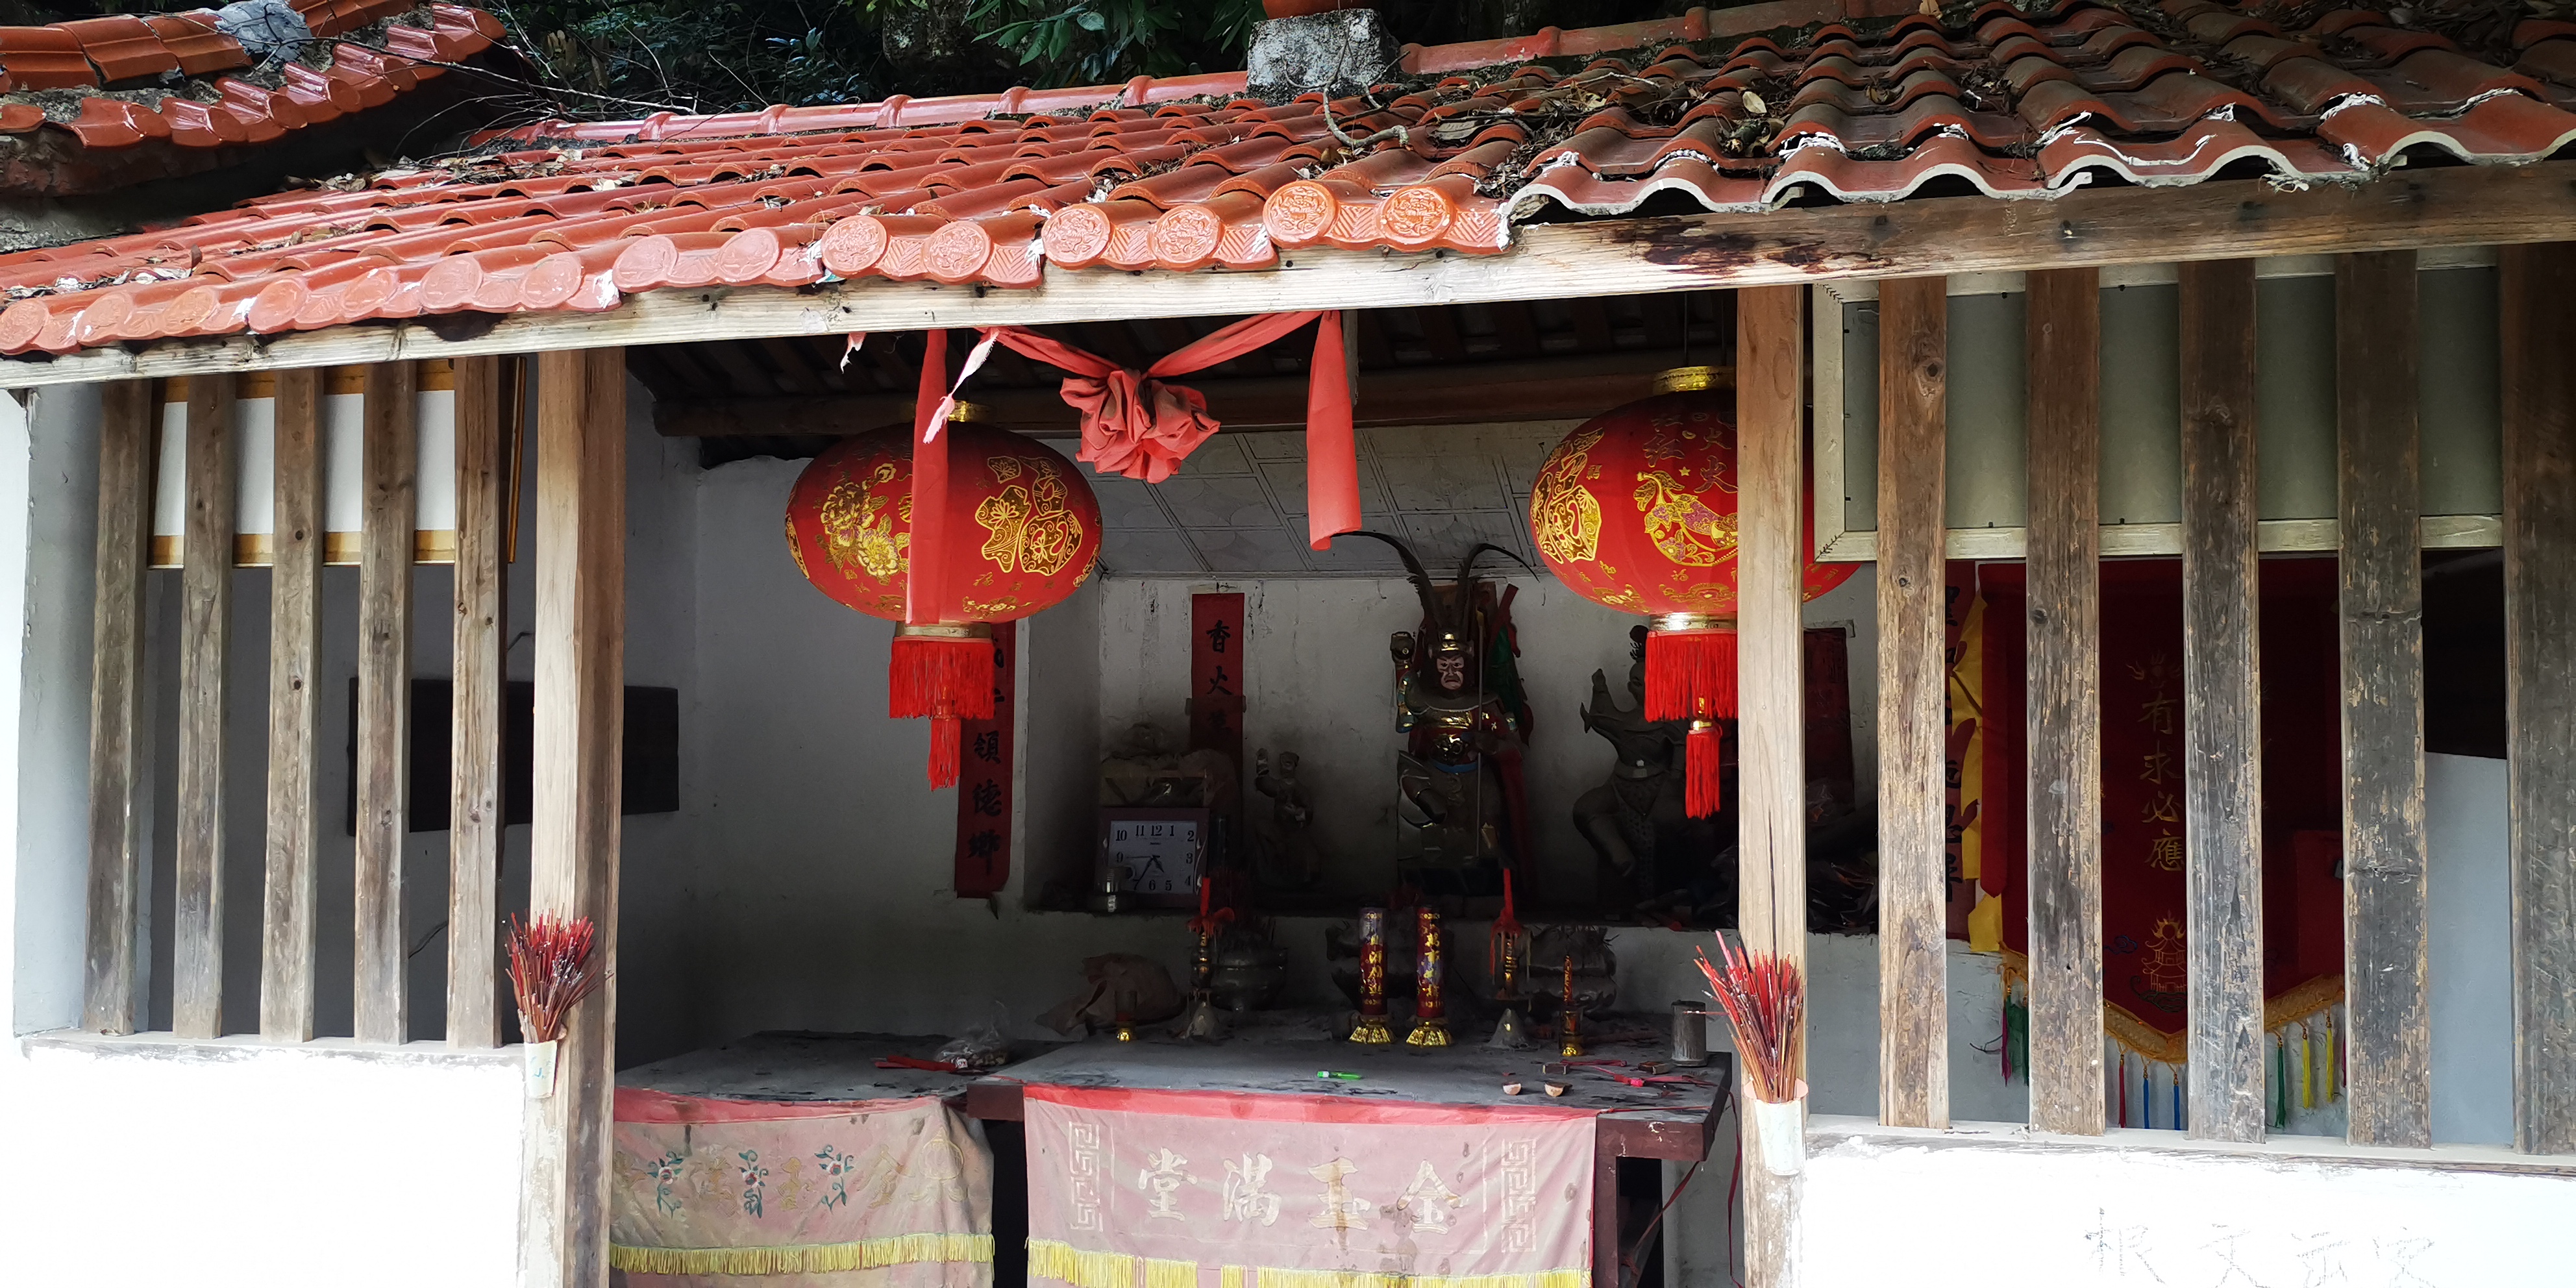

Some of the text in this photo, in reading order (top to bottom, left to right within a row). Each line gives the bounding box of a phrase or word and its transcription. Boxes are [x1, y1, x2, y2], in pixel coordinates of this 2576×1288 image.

[975, 456, 1083, 576] 福
[2136, 691, 2184, 872] 有求必應
[1115, 829, 1128, 841] 10
[1135, 824, 1145, 836] 11
[1150, 824, 1162, 836] 12
[1169, 824, 1174, 837] 1
[1187, 830, 1195, 842] 2
[1116, 852, 1123, 863] 9
[1185, 852, 1193, 864] 3
[1148, 879, 1156, 891] 6
[1165, 880, 1172, 891] 5
[1184, 876, 1191, 886] 4
